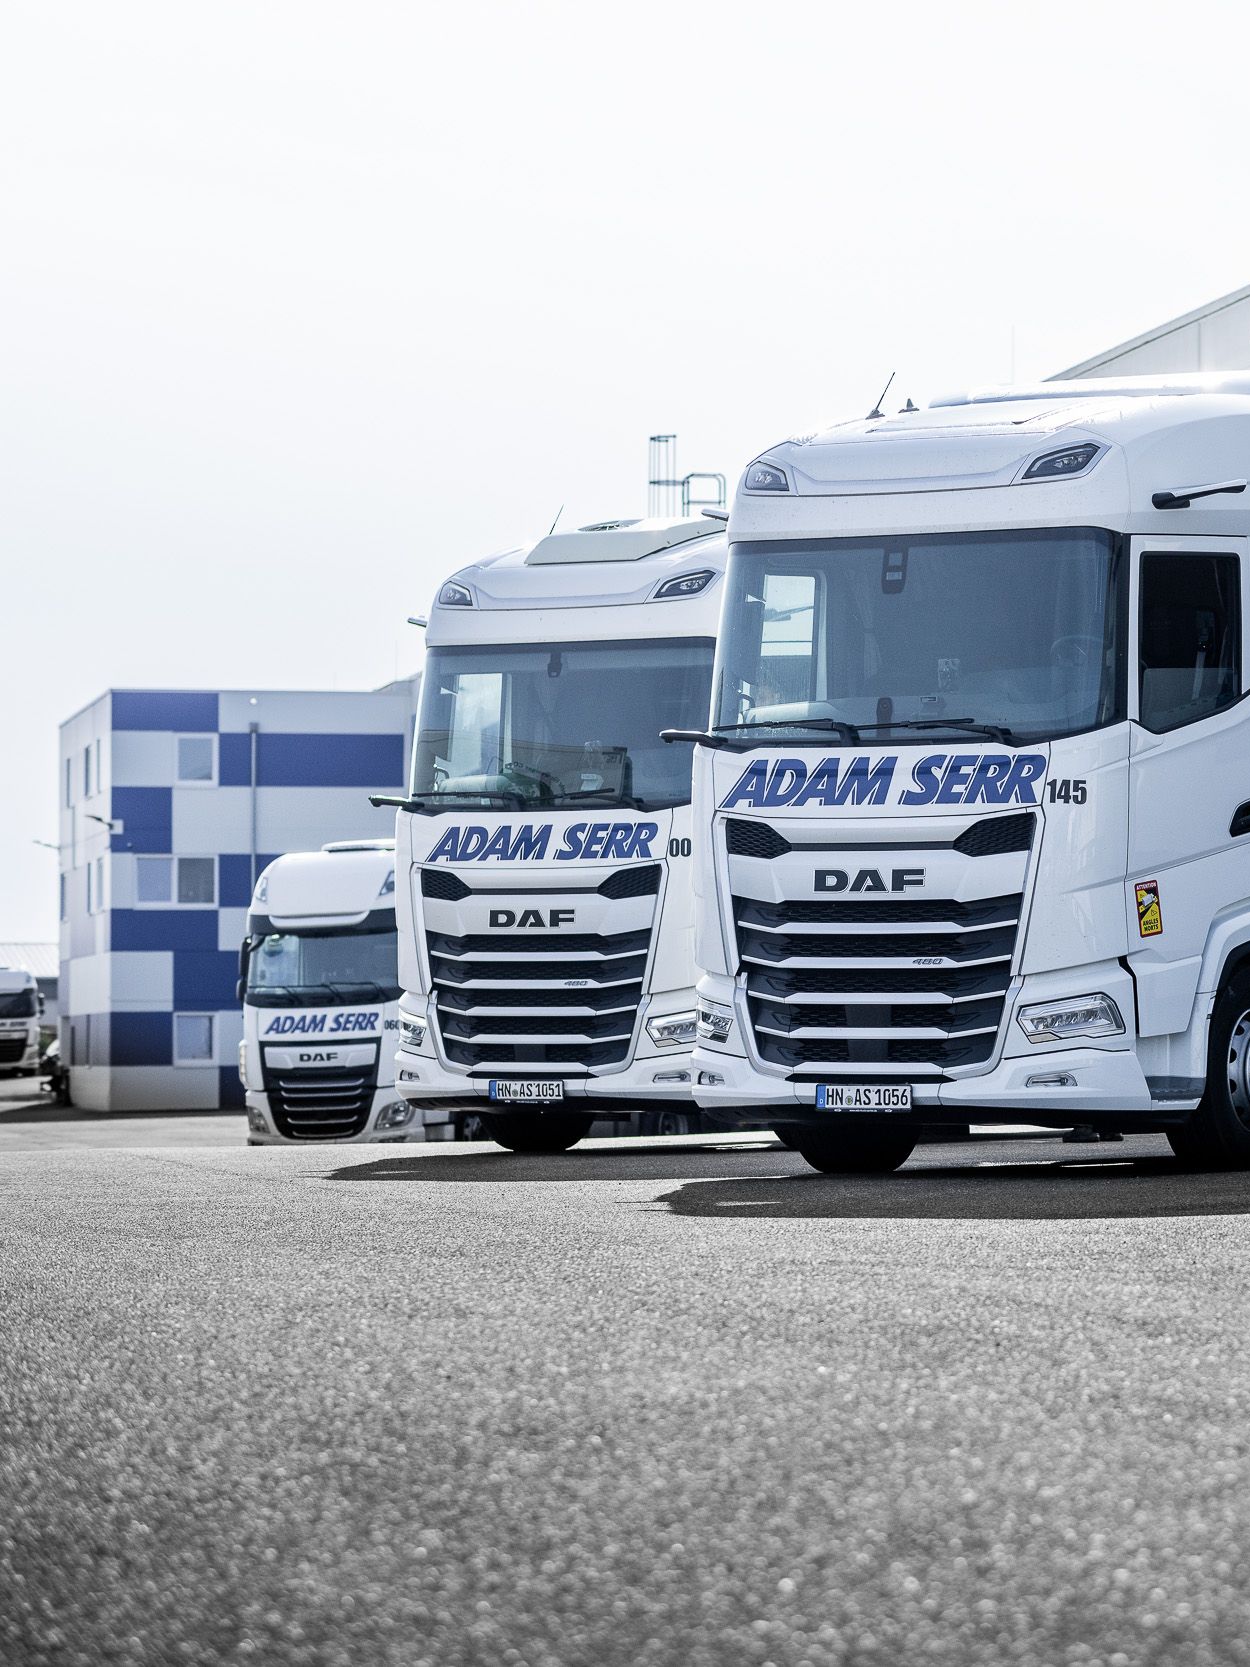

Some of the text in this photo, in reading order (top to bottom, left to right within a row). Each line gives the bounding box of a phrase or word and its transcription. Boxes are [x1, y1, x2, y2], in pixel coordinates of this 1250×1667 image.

[717, 754, 1047, 809] ADAM SERR
[1047, 779, 1088, 804] 145
[424, 822, 659, 862] ADAM SERR
[813, 867, 927, 893] DAF
[489, 908, 576, 928] DAF
[912, 957, 944, 966] 480
[264, 1012, 380, 1035] ADAM SERR
[299, 1052, 339, 1062] DAF
[497, 1083, 511, 1097] HN
[519, 1083, 533, 1097] AS
[535, 1083, 562, 1097] 1051
[826, 1088, 844, 1106] HN
[854, 1088, 872, 1106] AS
[874, 1088, 909, 1106] 1056
